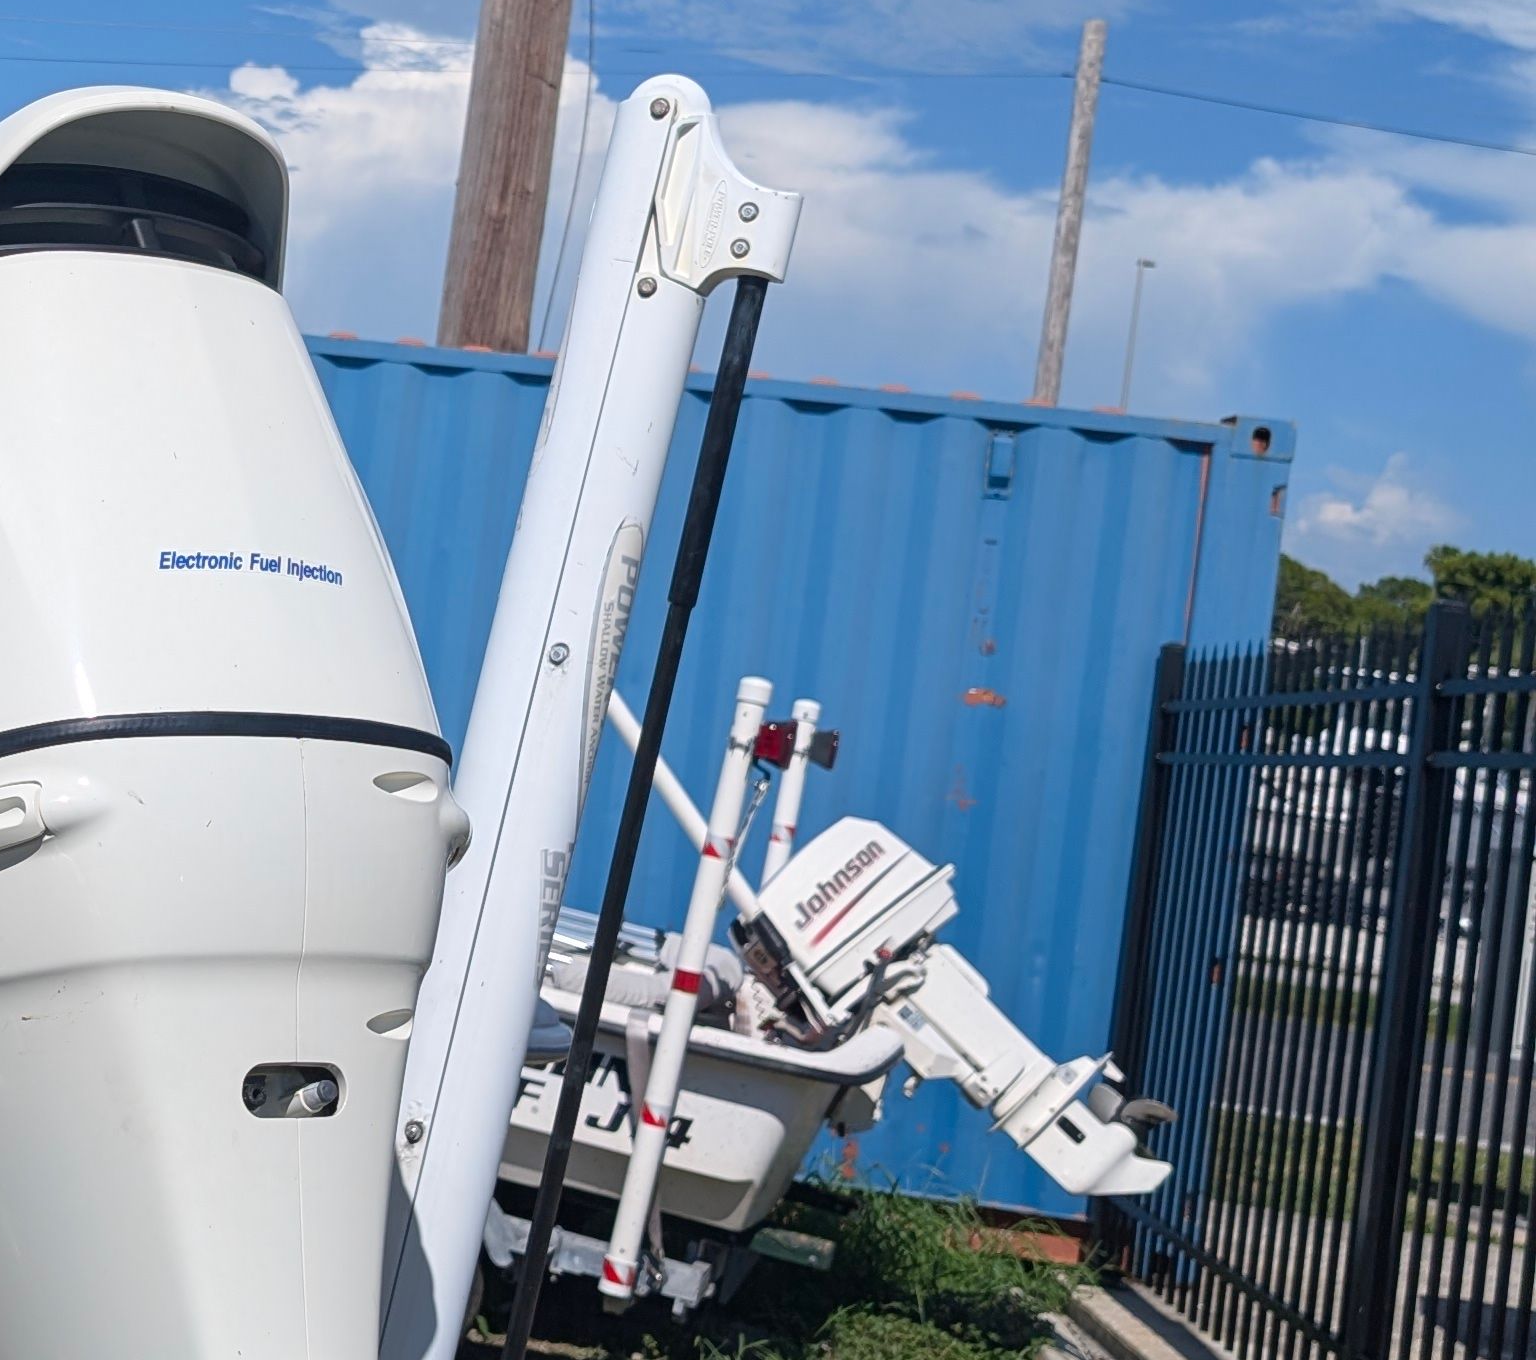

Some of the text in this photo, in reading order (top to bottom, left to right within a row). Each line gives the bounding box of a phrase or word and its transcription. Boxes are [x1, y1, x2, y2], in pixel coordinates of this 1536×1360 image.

[159, 551, 343, 586] Electronic Fuel Injection
[589, 669, 608, 723] WATER
[794, 839, 885, 931] Johnson
